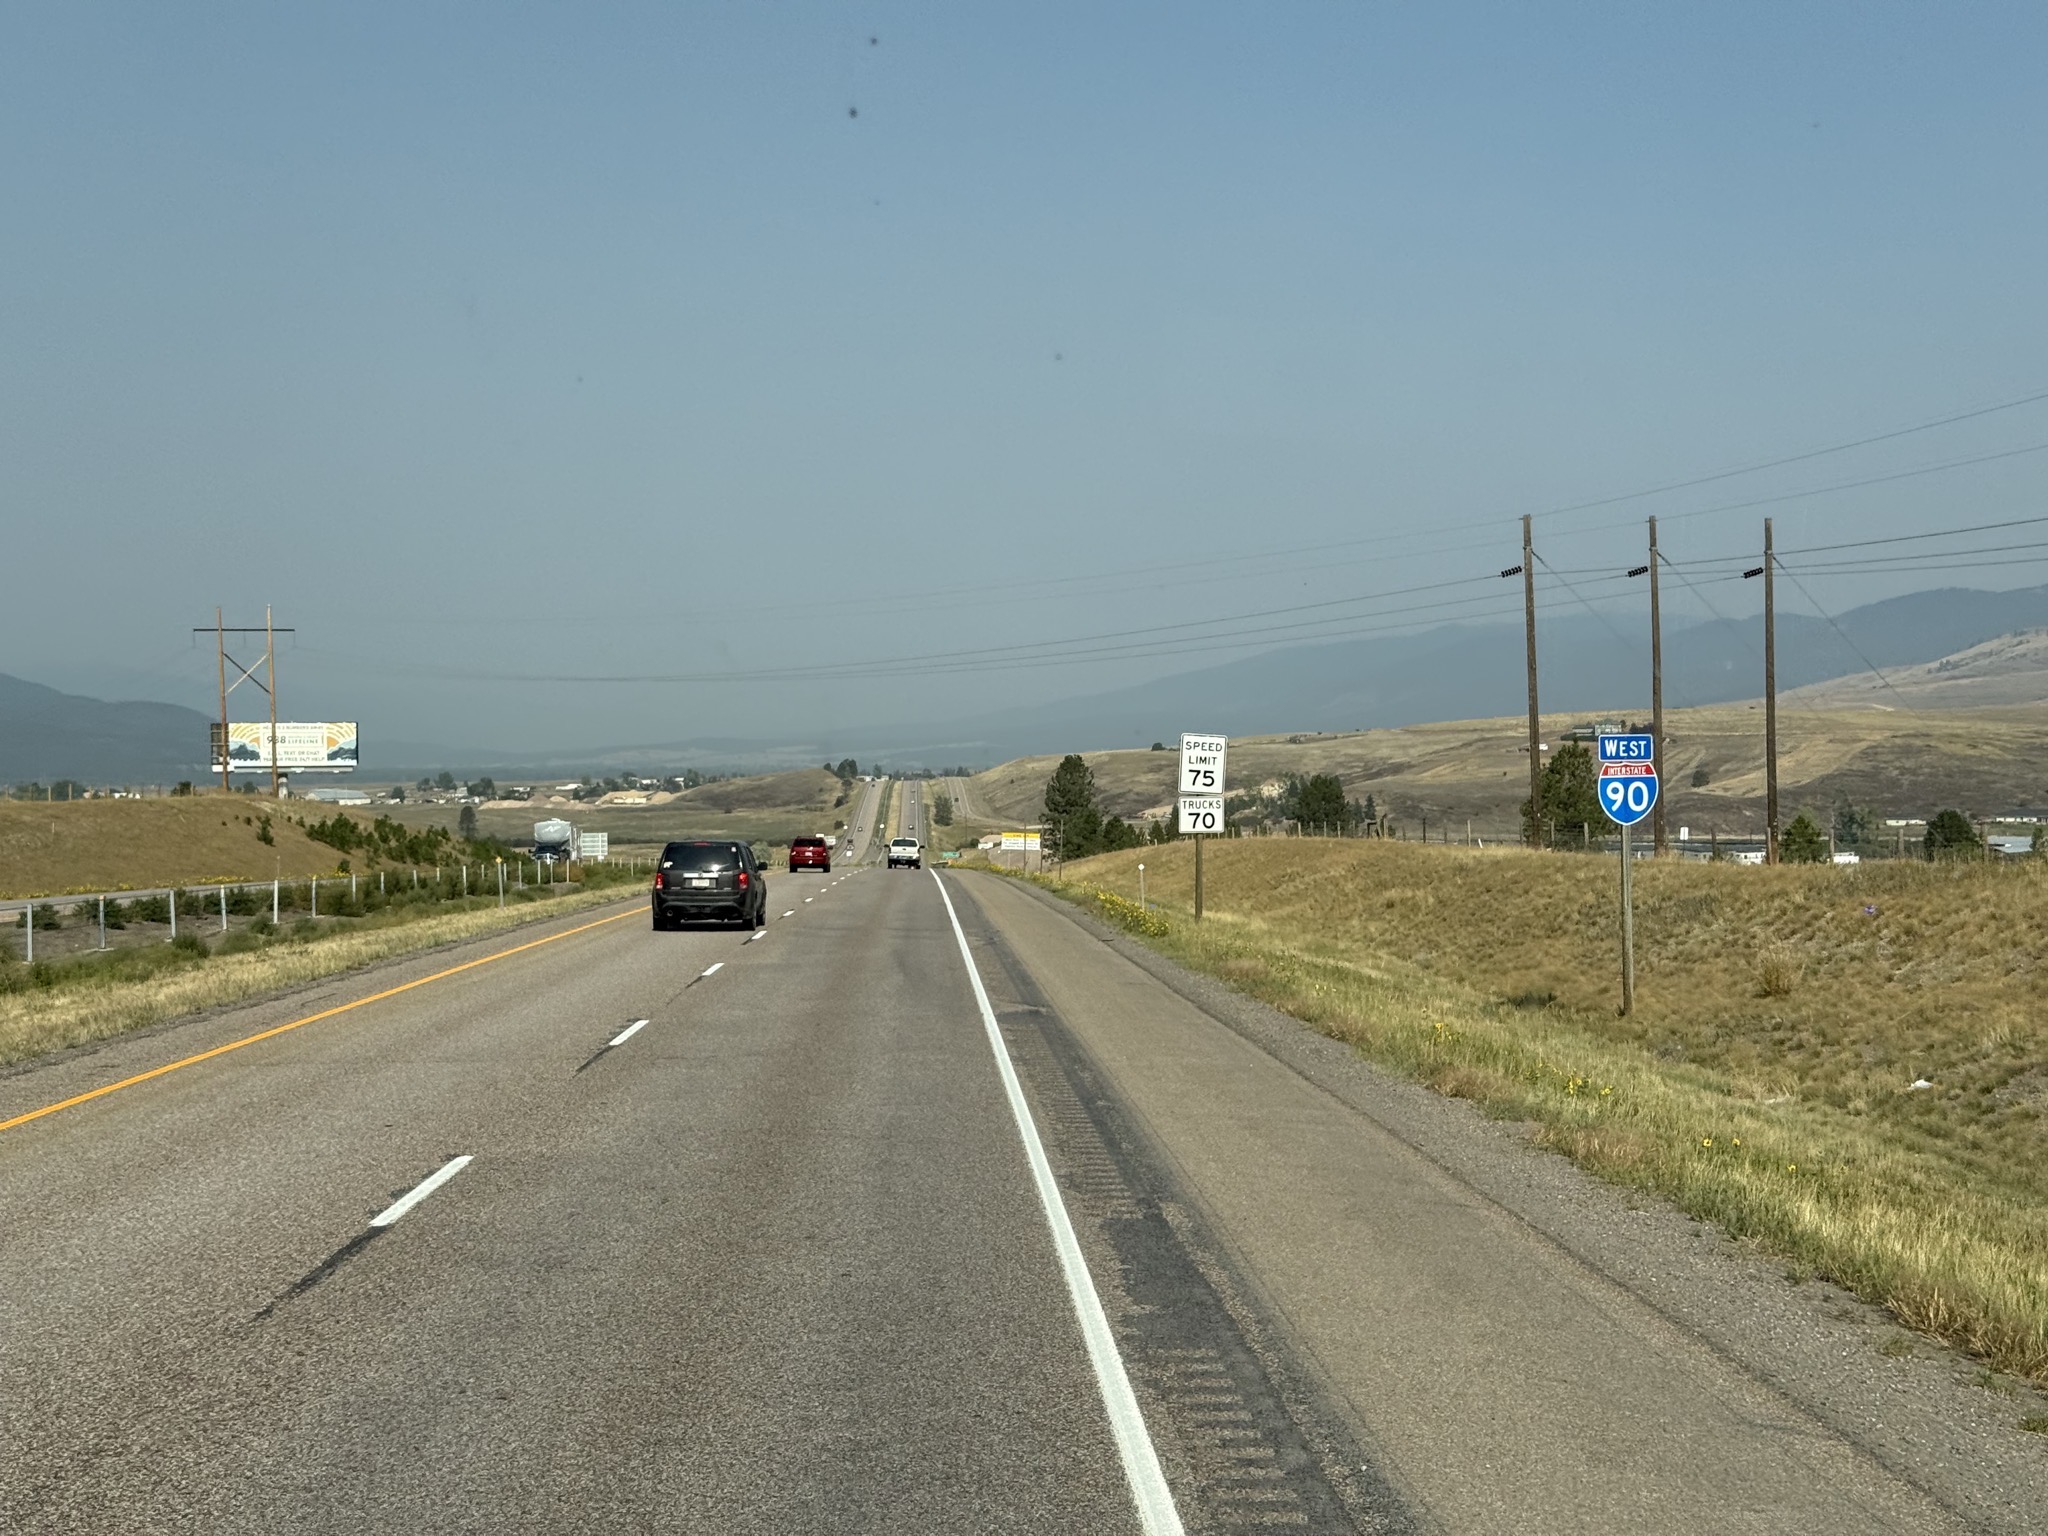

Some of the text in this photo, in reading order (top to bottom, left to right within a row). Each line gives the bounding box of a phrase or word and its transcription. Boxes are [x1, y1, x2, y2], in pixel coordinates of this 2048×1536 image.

[1185, 741, 1223, 752] SPEED
[1604, 739, 1647, 757] WEST
[1188, 755, 1218, 765] LIMIT
[1607, 766, 1647, 775] INTERSTATE
[1188, 769, 1215, 787] 75
[1606, 781, 1649, 812] 90
[1182, 800, 1222, 810] TRUCKS
[1188, 812, 1215, 829] 70
